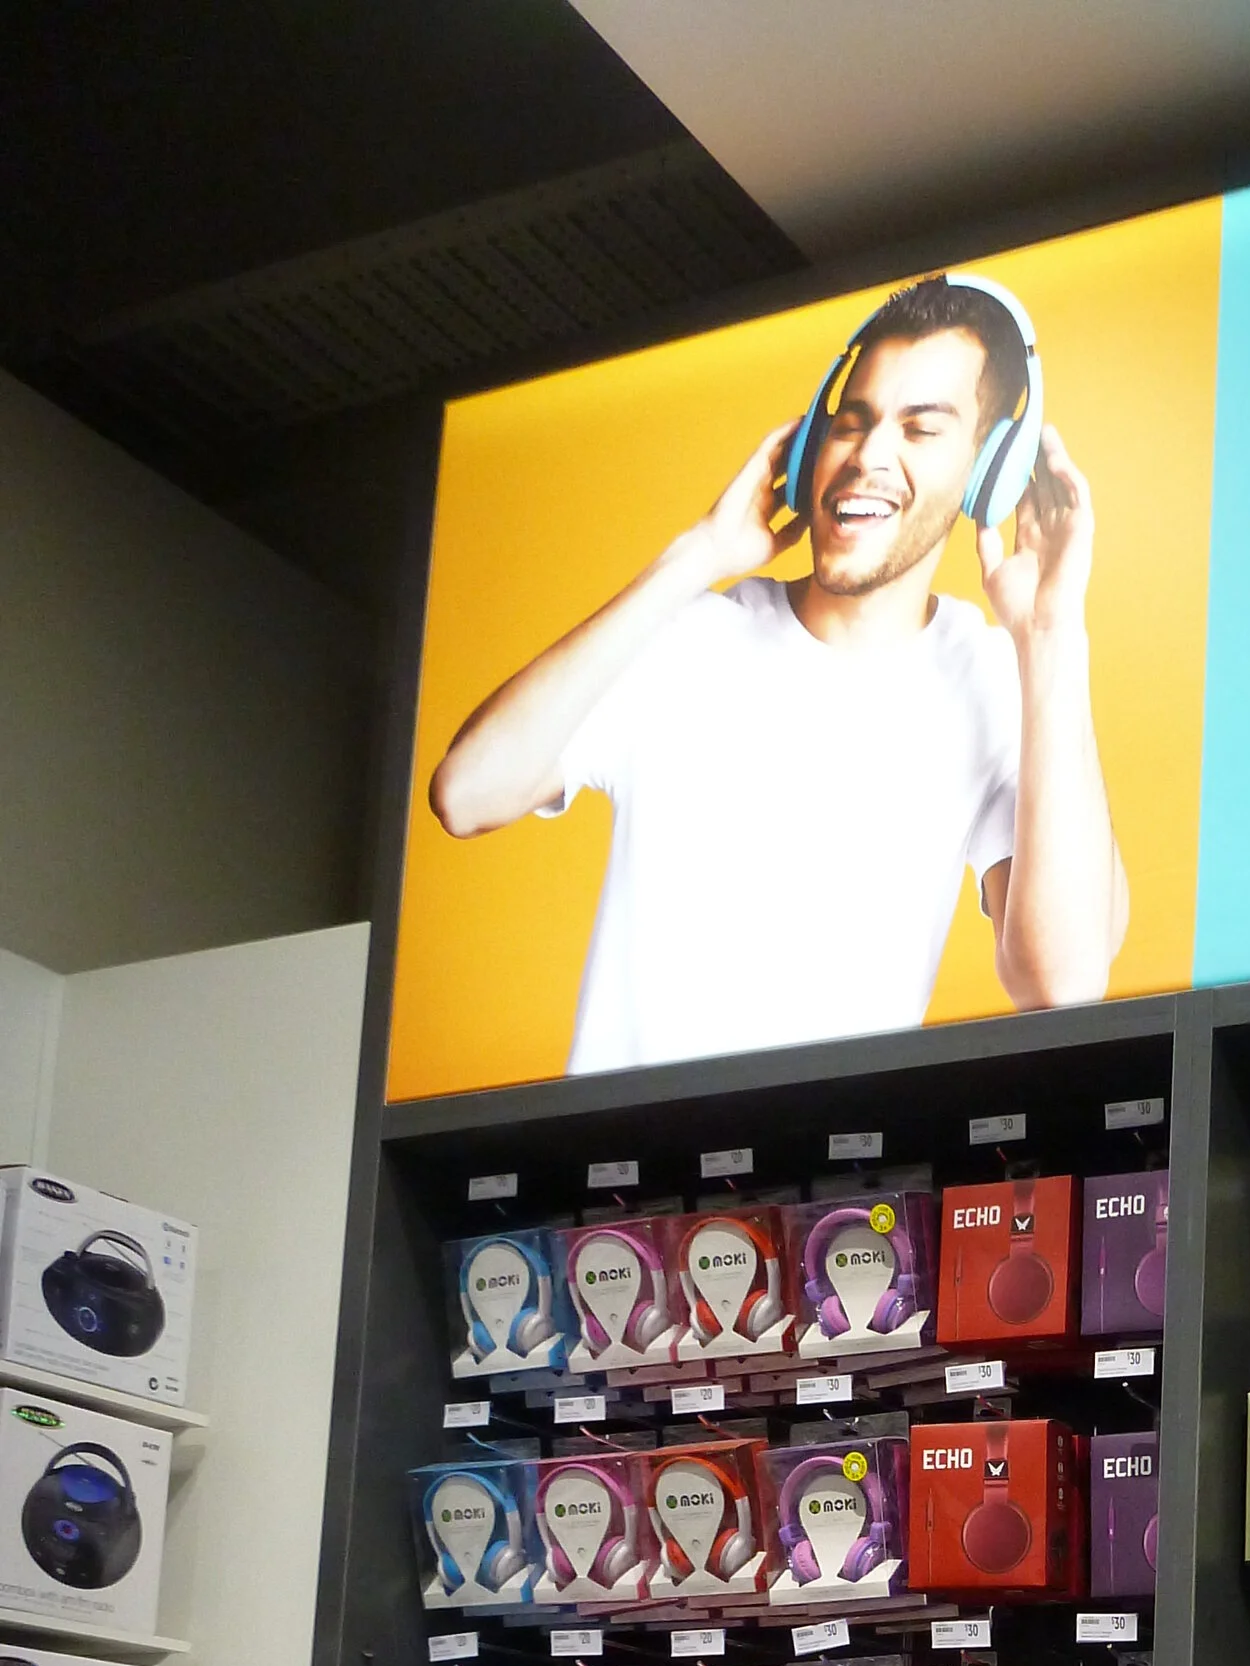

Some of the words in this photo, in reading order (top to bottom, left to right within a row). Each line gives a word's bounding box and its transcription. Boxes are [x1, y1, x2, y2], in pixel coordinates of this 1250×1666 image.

[1096, 1194, 1145, 1219] ECHO
[953, 1205, 1001, 1229] ECHO
[1127, 1352, 1141, 1365] $30
[979, 1365, 992, 1378] $30
[827, 1379, 839, 1391] $30
[922, 1448, 973, 1470] ECHO
[1103, 1456, 1152, 1479] ECHO
[824, 1623, 838, 1636] $30
[1111, 1616, 1126, 1630] $30
[965, 1624, 979, 1637] $30
